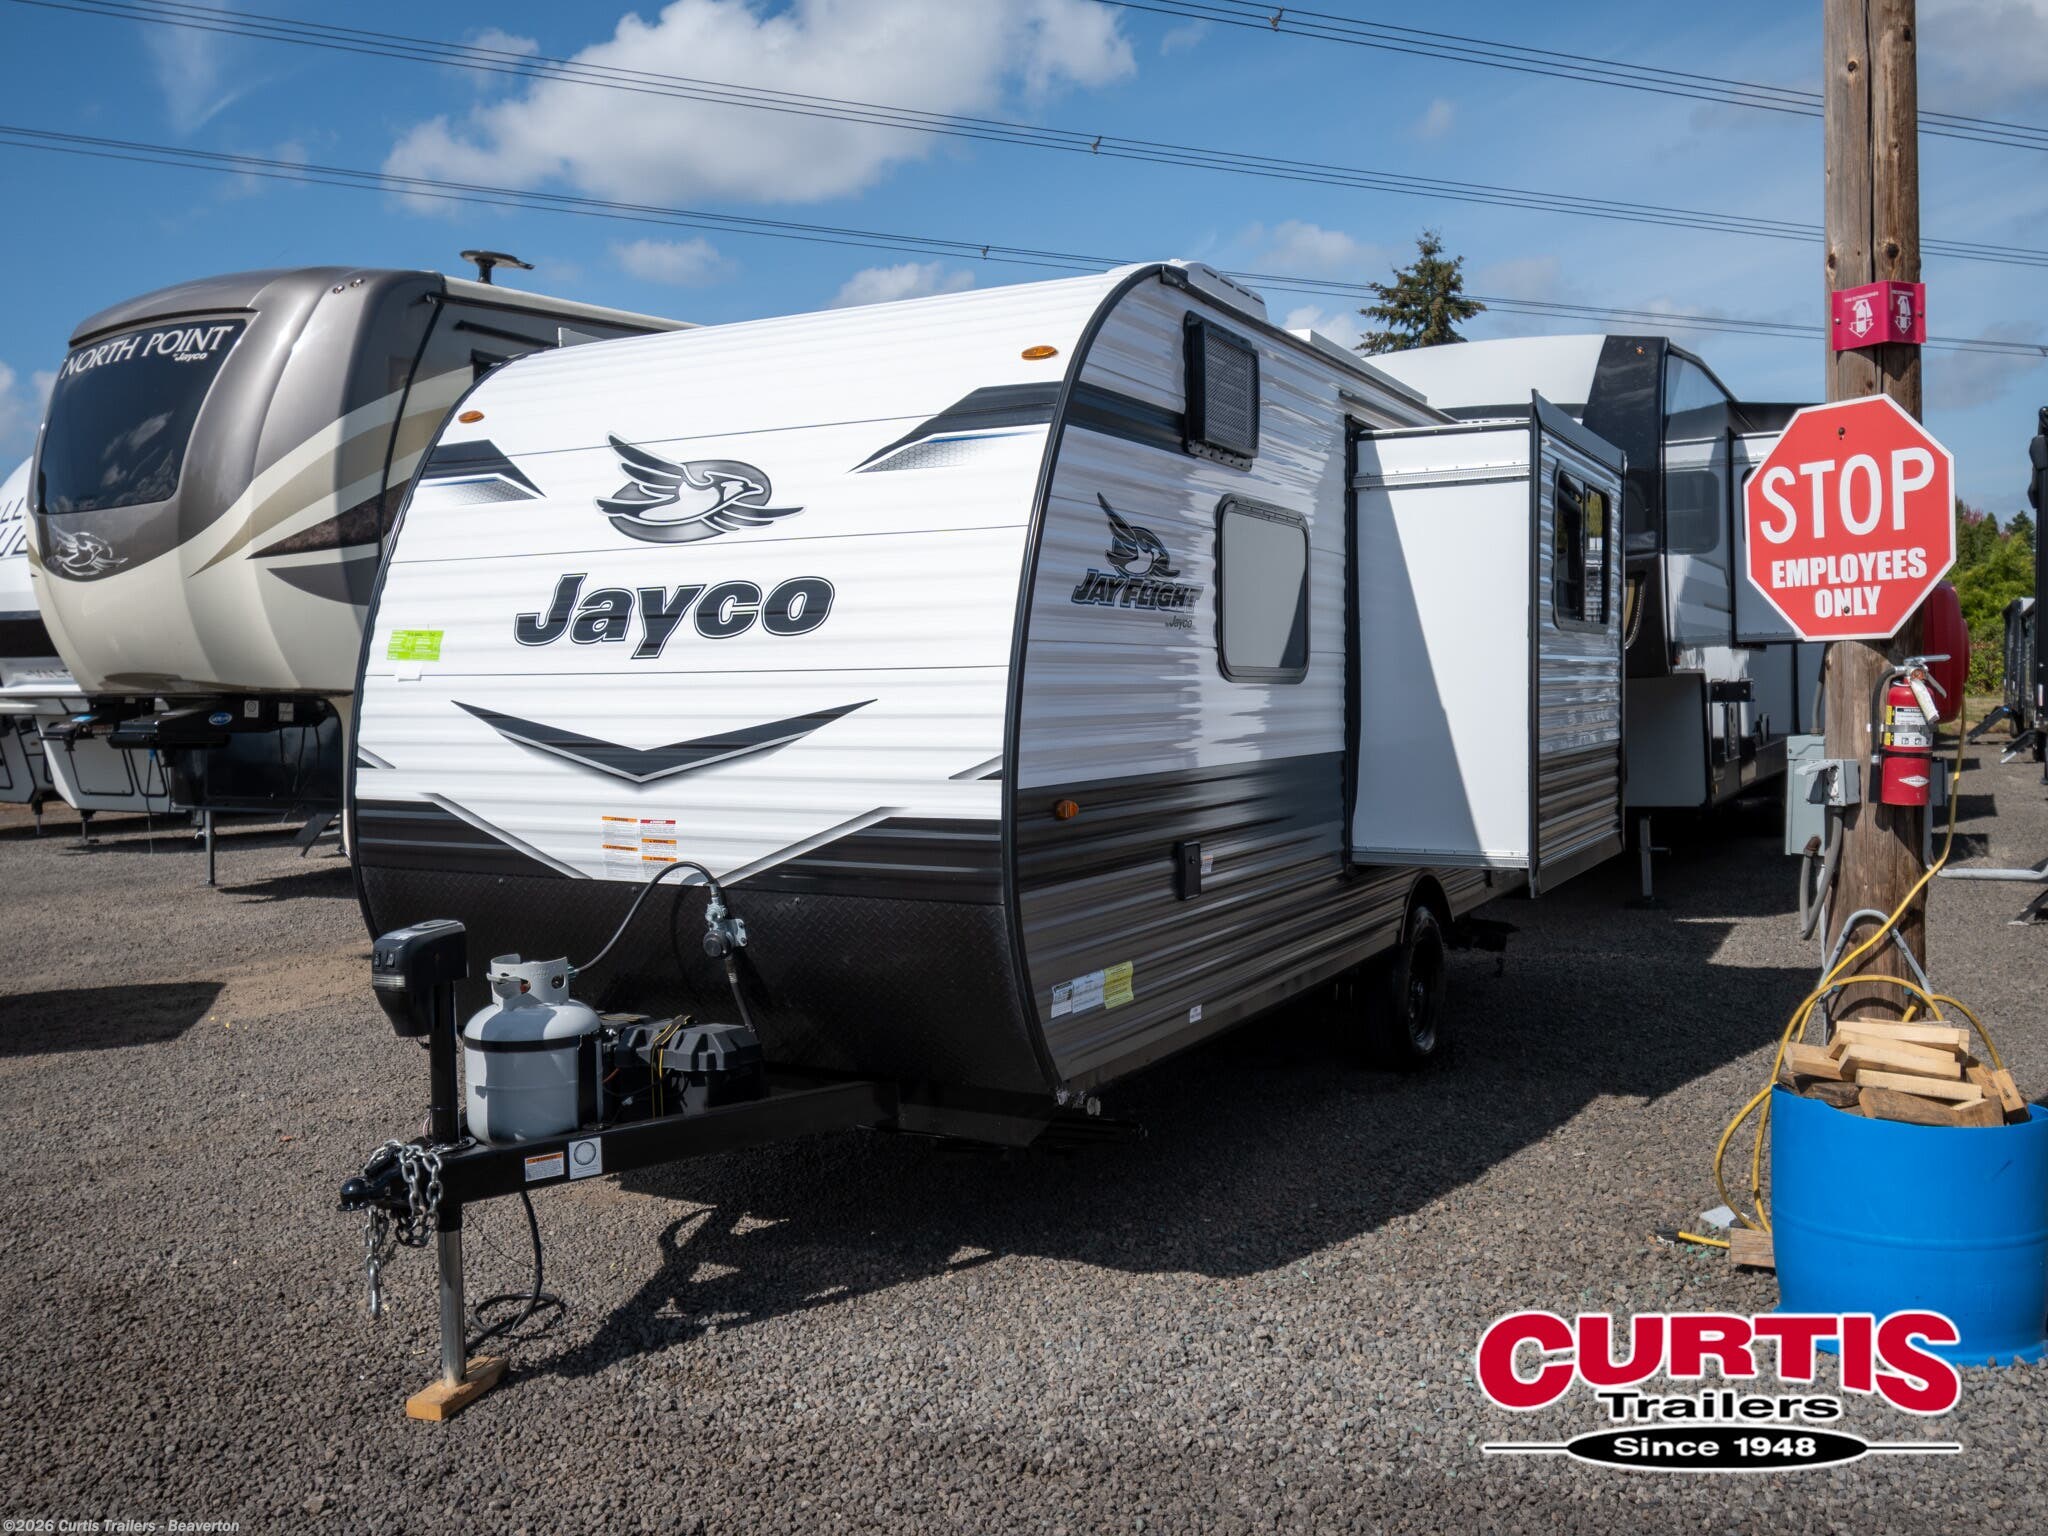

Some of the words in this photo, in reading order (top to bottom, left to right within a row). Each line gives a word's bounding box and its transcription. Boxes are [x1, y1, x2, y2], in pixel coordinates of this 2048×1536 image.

[61, 336, 142, 379] NORTH
[141, 326, 234, 357] POINT
[175, 352, 208, 362] Jayco
[1760, 447, 1935, 545] STOP
[1070, 568, 1126, 607] JAY
[1119, 577, 1205, 614] FLIGHT
[1771, 547, 1928, 589] EMPLOYEES
[513, 572, 836, 660] Jayco
[1814, 586, 1882, 619] ONLY
